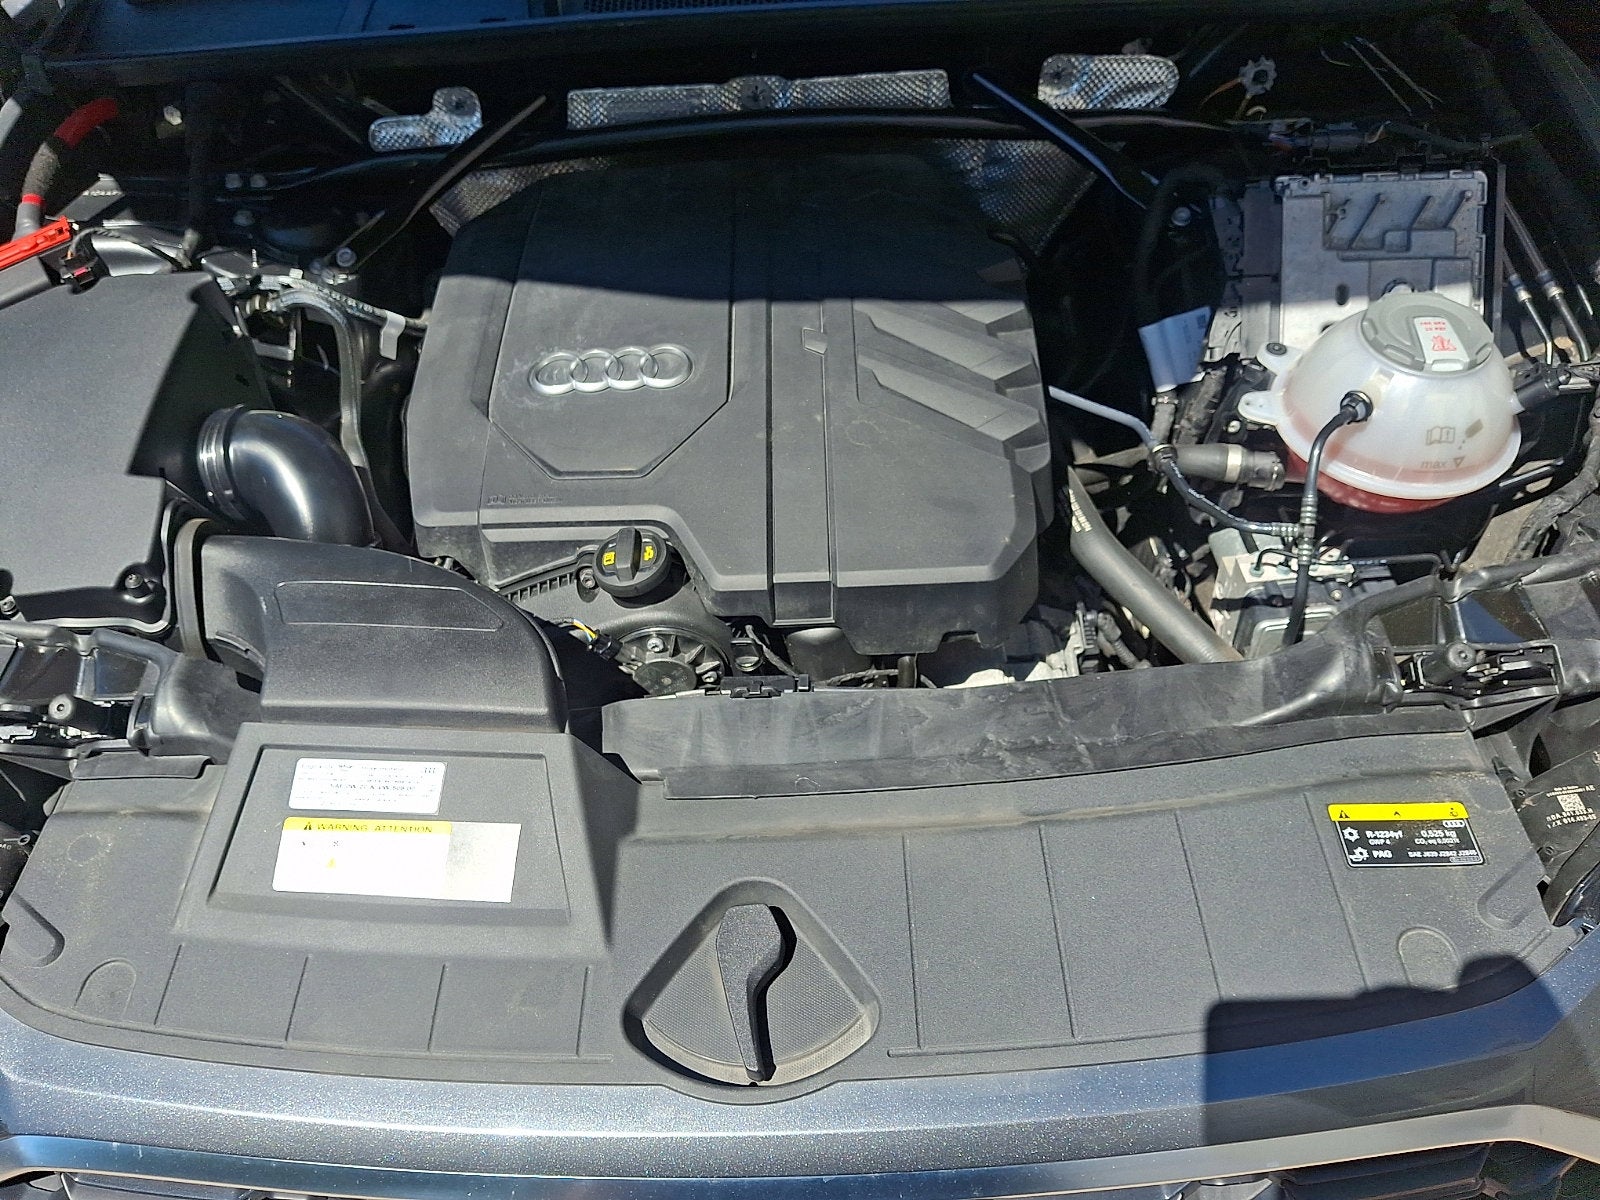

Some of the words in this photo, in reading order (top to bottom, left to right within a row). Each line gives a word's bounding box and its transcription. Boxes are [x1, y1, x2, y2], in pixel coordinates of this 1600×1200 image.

[1420, 460, 1447, 469] max
[1444, 829, 1457, 838] kg
[1372, 849, 1393, 858] PAG
